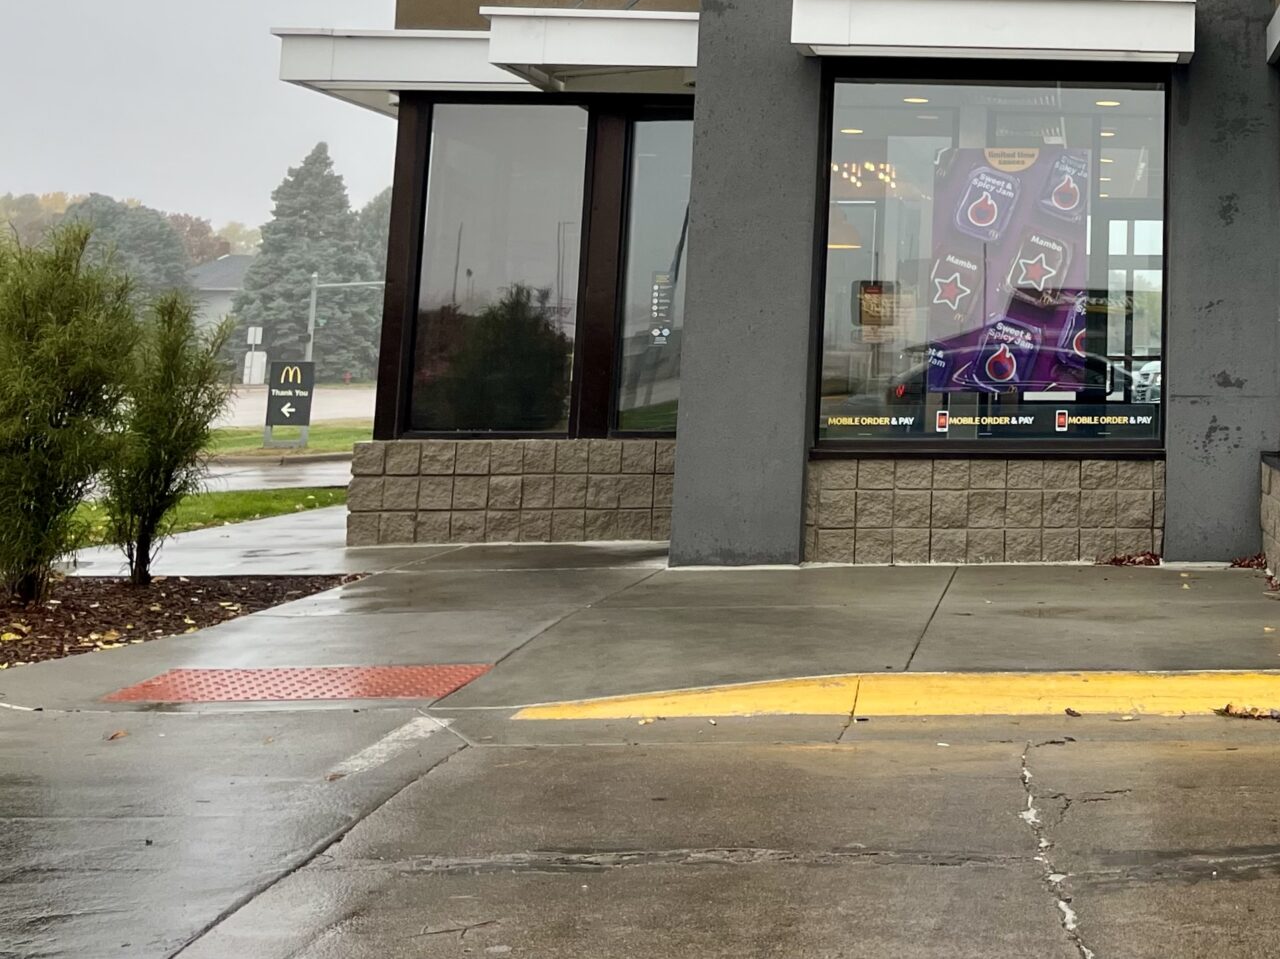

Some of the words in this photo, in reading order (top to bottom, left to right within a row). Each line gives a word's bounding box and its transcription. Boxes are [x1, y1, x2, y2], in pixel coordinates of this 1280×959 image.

[980, 173, 1005, 187] Sweet
[971, 178, 996, 192] Spicy
[995, 187, 1015, 198] Jam
[1031, 235, 1063, 252] Mambo
[946, 254, 977, 271] Mambo
[989, 328, 1015, 343] Spicy
[1014, 337, 1034, 350] Jam
[996, 322, 1025, 339] Sweet
[1025, 331, 1033, 341] &
[271, 388, 293, 397] Thank
[294, 389, 309, 397] You
[827, 417, 860, 426] MOBILE
[861, 417, 890, 426] ORDER
[890, 417, 898, 426] &
[898, 417, 915, 426] PAY
[948, 416, 980, 425] MOBILE
[981, 416, 1010, 425] ORDER
[1010, 416, 1018, 425] &
[1018, 416, 1035, 425] PAY
[1068, 416, 1099, 425] MOBILE
[1100, 416, 1129, 425] ORDER
[1129, 416, 1136, 425] &
[1137, 416, 1153, 425] PAY
